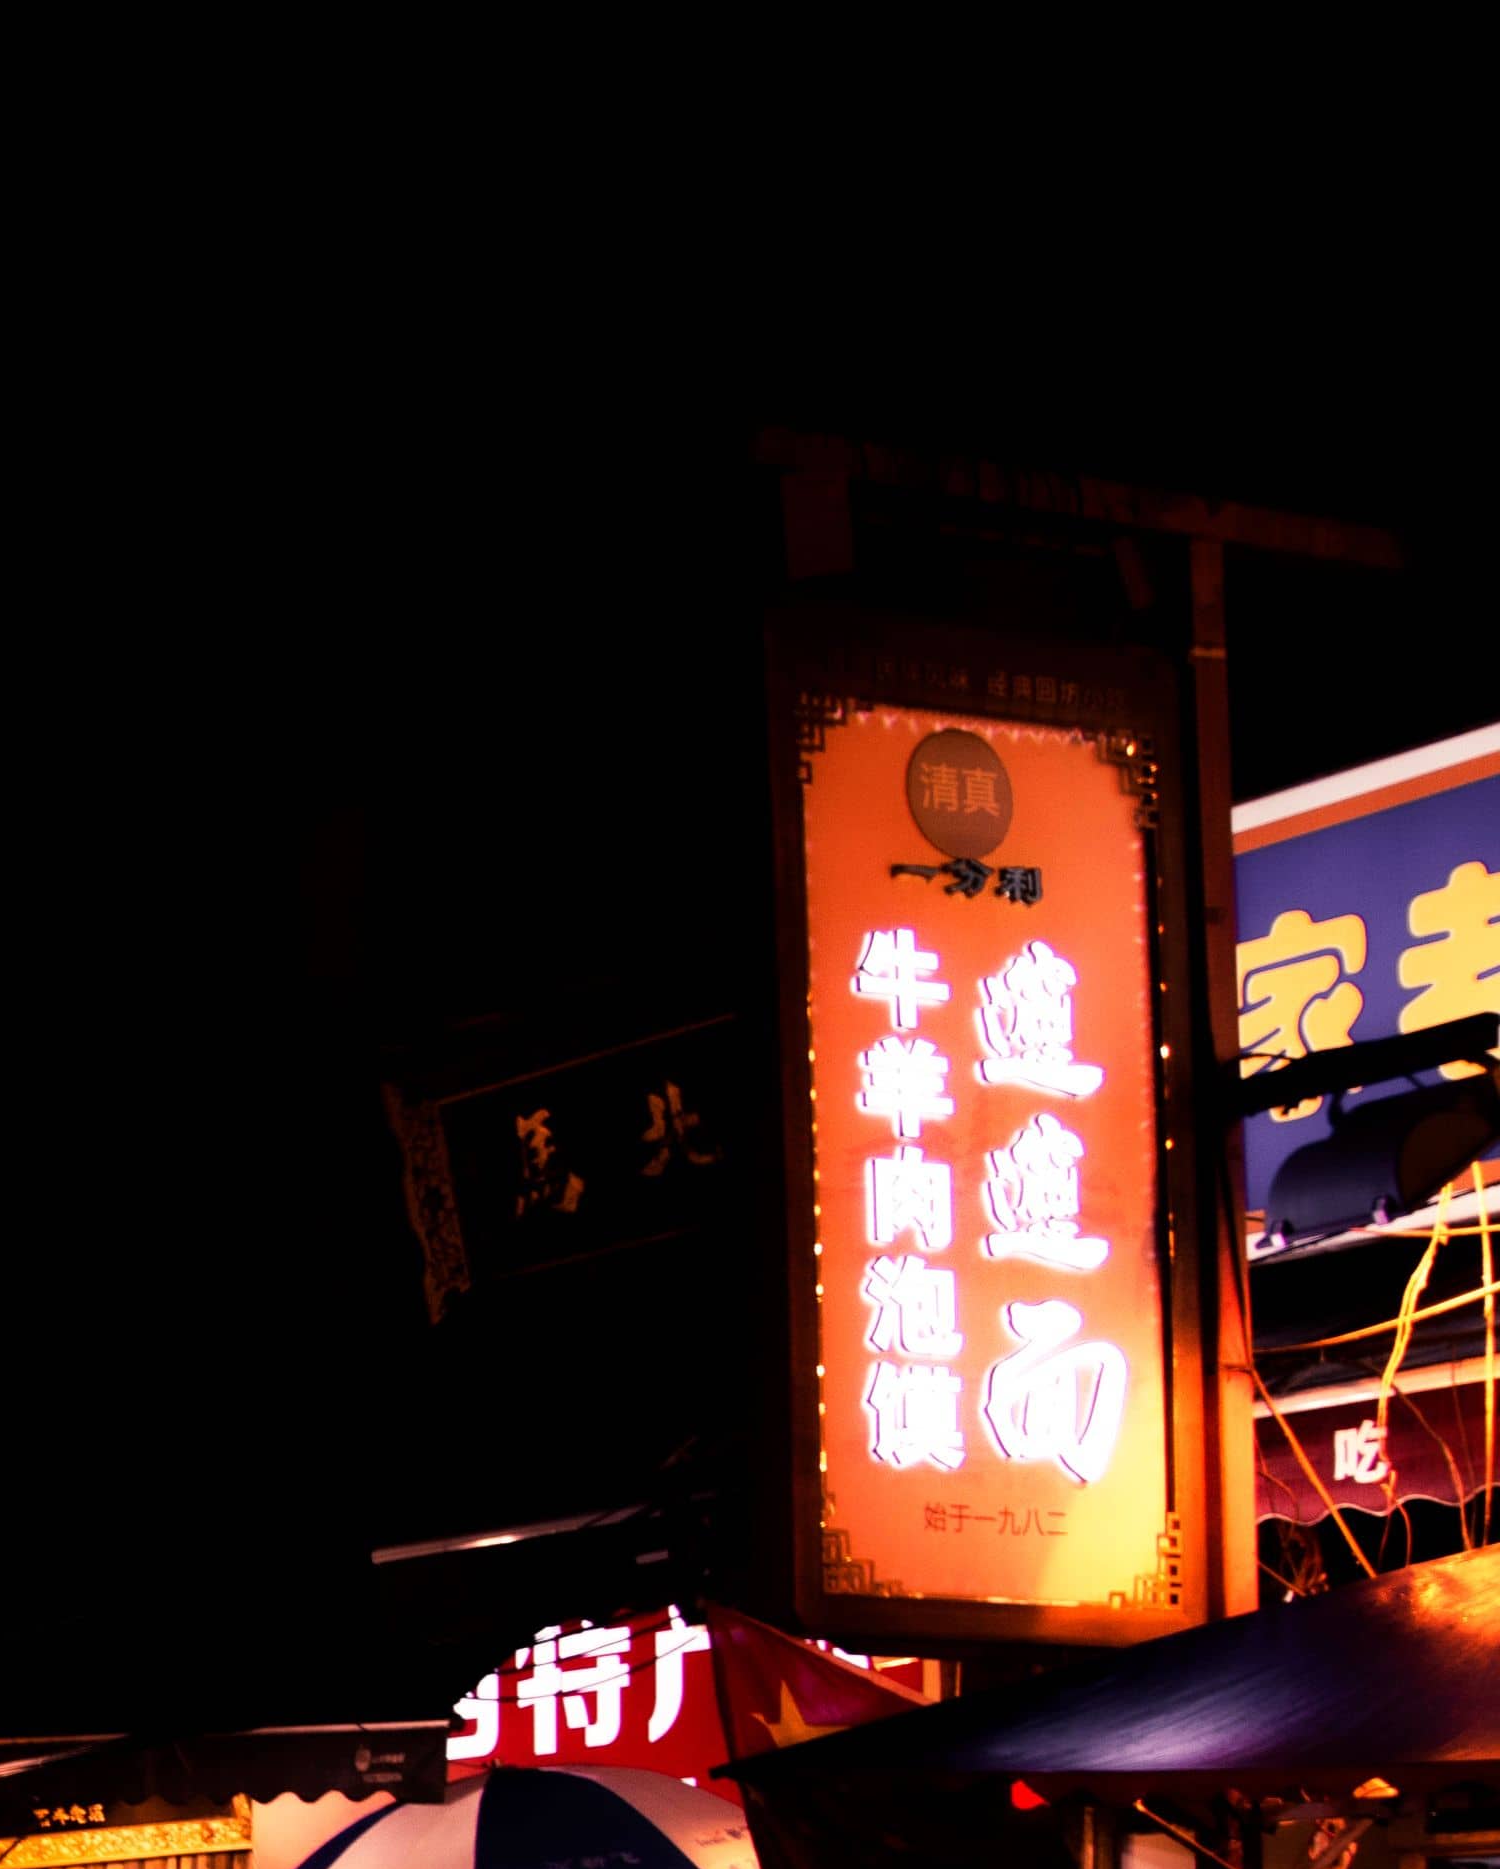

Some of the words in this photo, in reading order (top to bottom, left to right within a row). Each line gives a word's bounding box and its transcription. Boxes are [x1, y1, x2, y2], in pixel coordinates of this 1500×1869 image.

[920, 762, 1000, 817] 清真
[924, 1502, 1068, 1538] 始于一九八二
